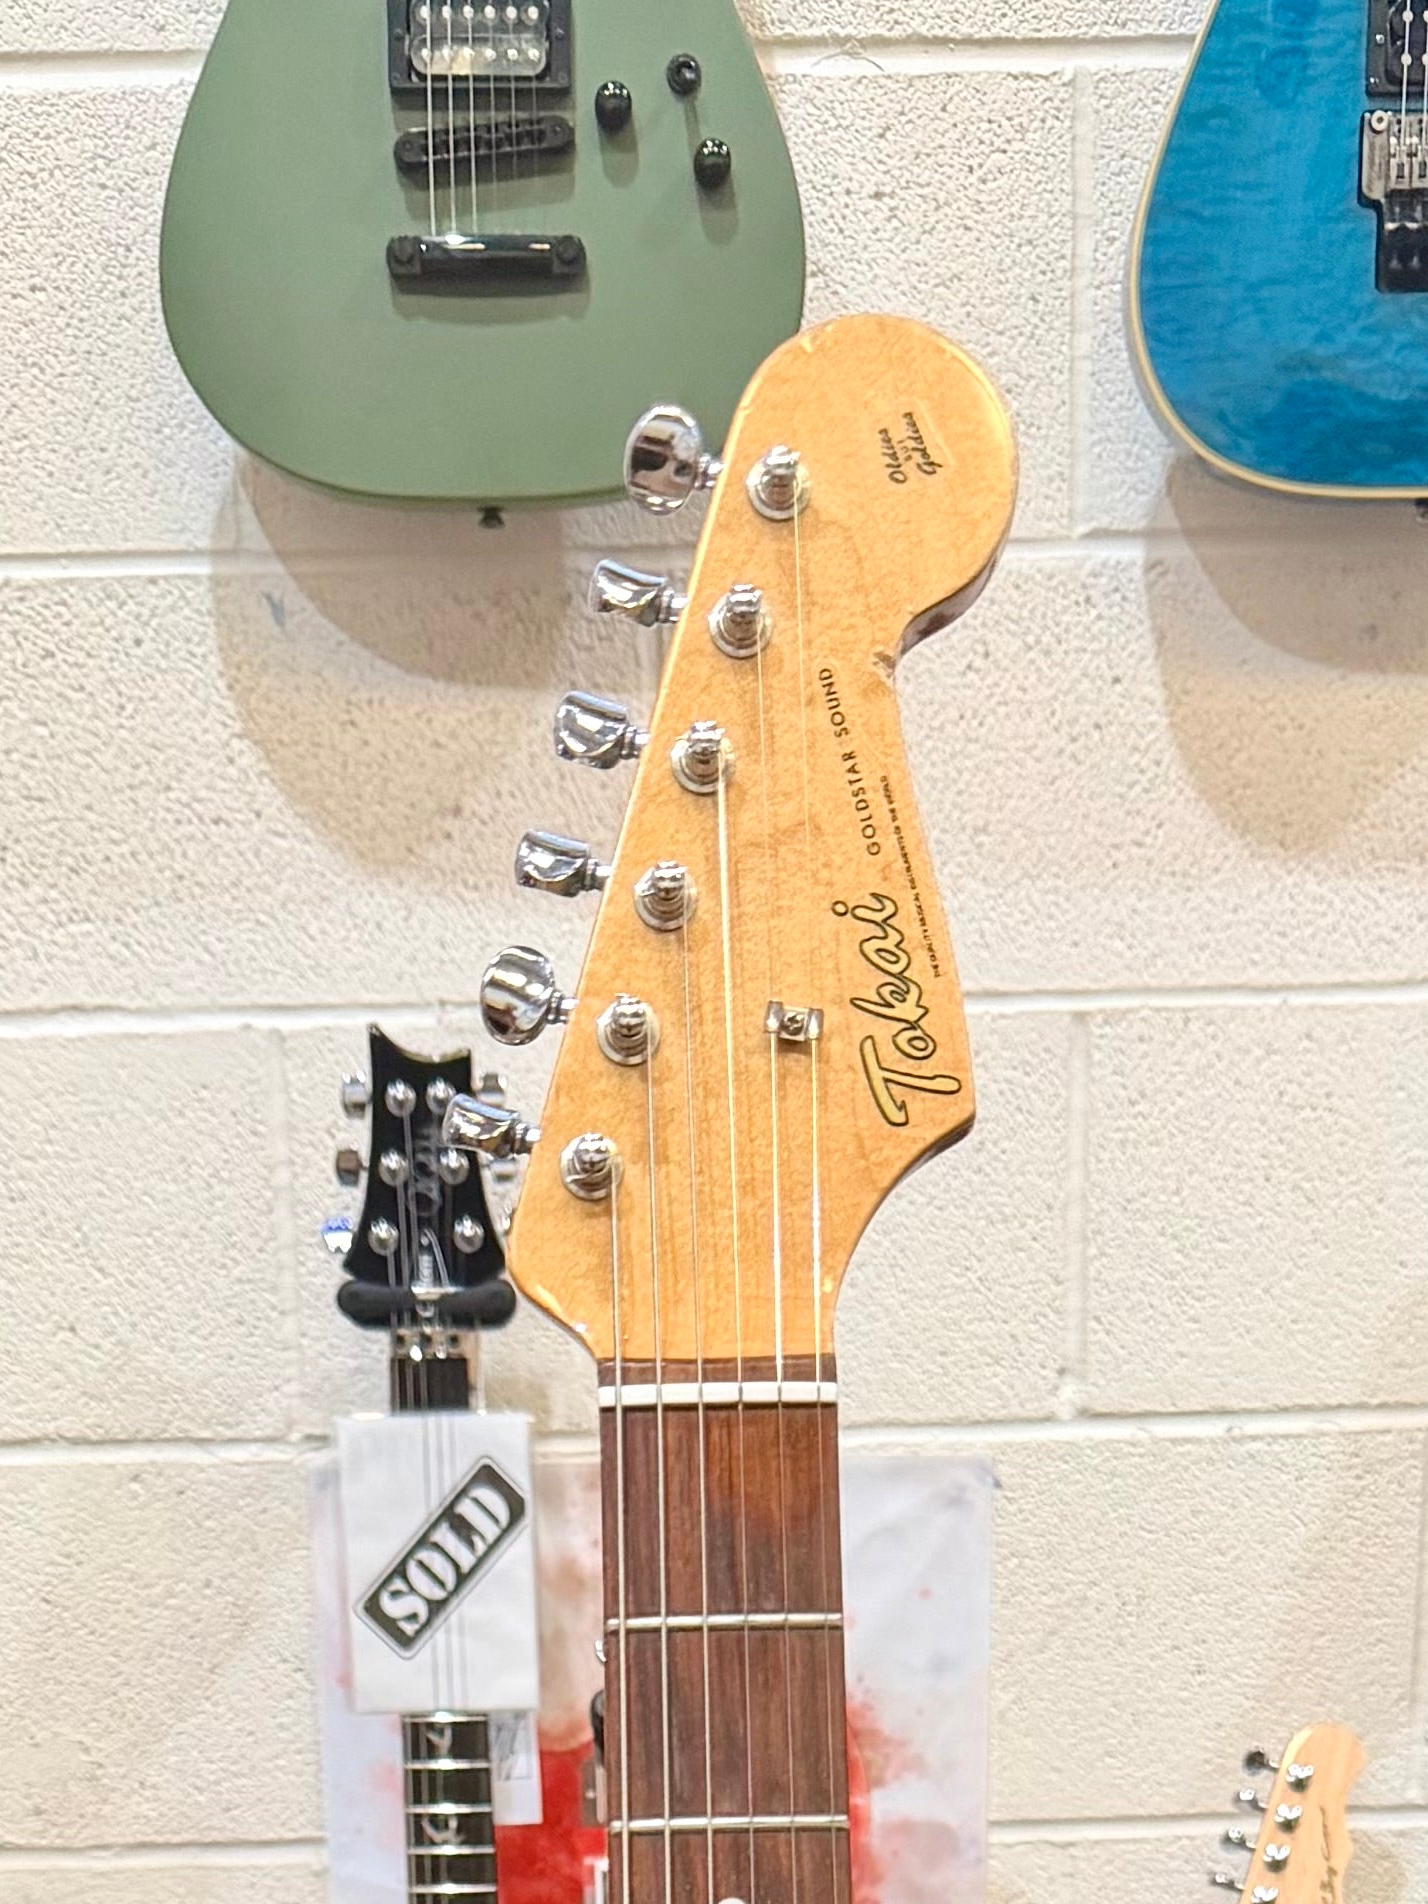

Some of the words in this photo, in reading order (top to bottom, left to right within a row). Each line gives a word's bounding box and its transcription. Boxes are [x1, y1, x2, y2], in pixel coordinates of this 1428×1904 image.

[819, 668, 849, 738] SOUND
[841, 751, 881, 857] GOLDSTAR
[832, 892, 962, 1127] Tokai
[379, 1486, 511, 1637] SOLD
